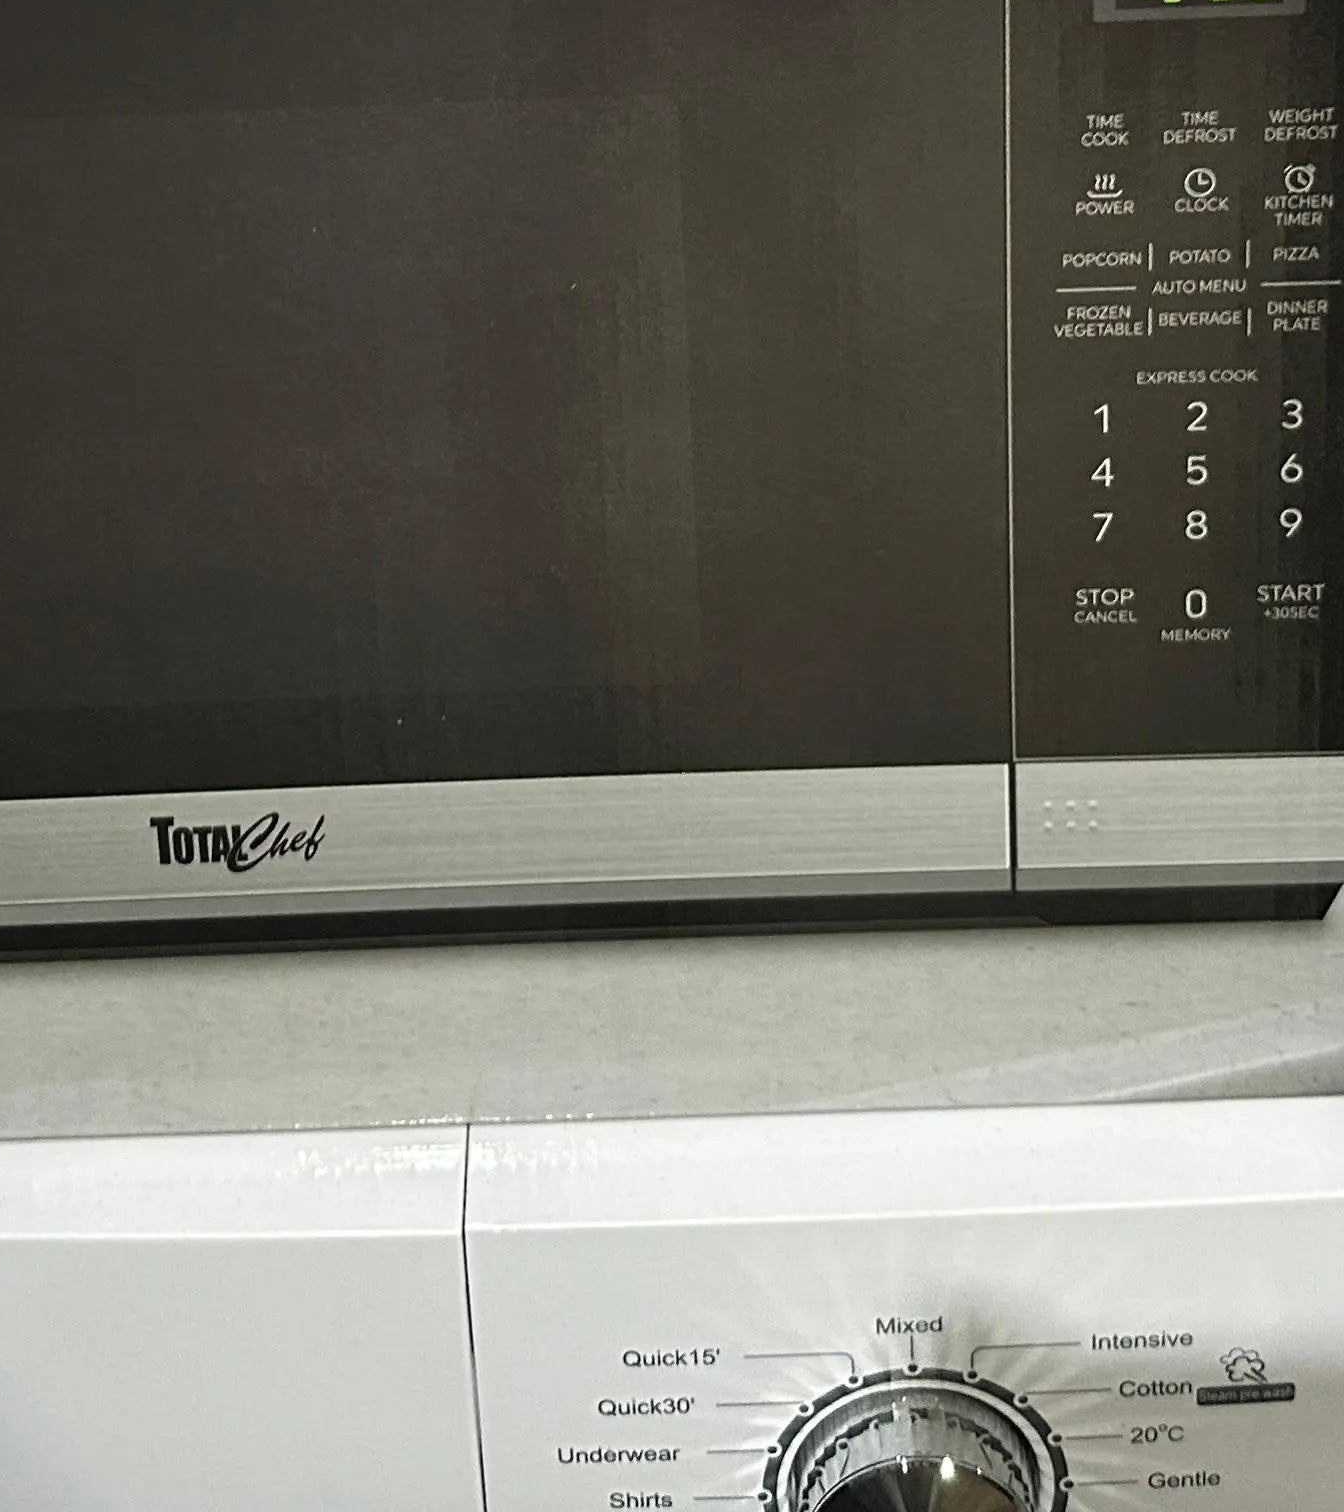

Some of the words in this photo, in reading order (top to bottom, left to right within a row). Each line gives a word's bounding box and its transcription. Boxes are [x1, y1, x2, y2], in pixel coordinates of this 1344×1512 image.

[1086, 113, 1125, 130] TIME
[1181, 109, 1220, 126] TIME
[1268, 106, 1336, 124] WEIGHT
[1080, 130, 1130, 147] COOK
[1163, 127, 1237, 145] DEFROST
[1264, 124, 1339, 142] DEFROST
[1075, 199, 1135, 216] POWER
[1174, 196, 1230, 213] CLOCK
[1264, 194, 1335, 210] KITCHEN
[1274, 211, 1323, 226] TIMER
[1062, 251, 1142, 268] POPCORN
[1169, 248, 1231, 265] POTATO
[1273, 246, 1320, 262] PIZZA
[1152, 279, 1196, 296] AUTO
[1199, 278, 1247, 294] MENU
[1066, 305, 1132, 320] FROZEN
[1267, 299, 1329, 316] DINNER
[1158, 310, 1242, 327] BEVERAGE
[1272, 316, 1321, 332] PLATE
[1053, 320, 1144, 338] VEGETABLE
[1136, 369, 1206, 385] EXPRESS
[1209, 368, 1259, 383] COOK
[1093, 402, 1109, 434] 1
[1186, 400, 1209, 432] 2
[1281, 398, 1304, 430] 3
[1090, 457, 1115, 487] 4
[1185, 454, 1208, 486] 5
[1280, 452, 1304, 484] 6
[1093, 512, 1114, 542] 7
[1184, 509, 1208, 540] 8
[1279, 507, 1303, 539] 9
[1074, 588, 1135, 607] STOP
[1256, 582, 1326, 604] START
[1184, 589, 1208, 620] 0
[1263, 605, 1321, 621] +30SEC
[1073, 609, 1137, 625] CANCEL
[1160, 628, 1231, 643] MEMORY
[876, 1316, 943, 1334] Mixed
[1091, 1330, 1194, 1352] Intensive
[622, 1347, 721, 1368] Quick15'
[1119, 1380, 1193, 1398] Cotton
[597, 1396, 695, 1417] Quick30'
[1130, 1423, 1185, 1444] 20°C
[557, 1446, 681, 1464] Underwear
[1148, 1470, 1221, 1489] Gentle
[609, 1491, 673, 1509] Shirts
